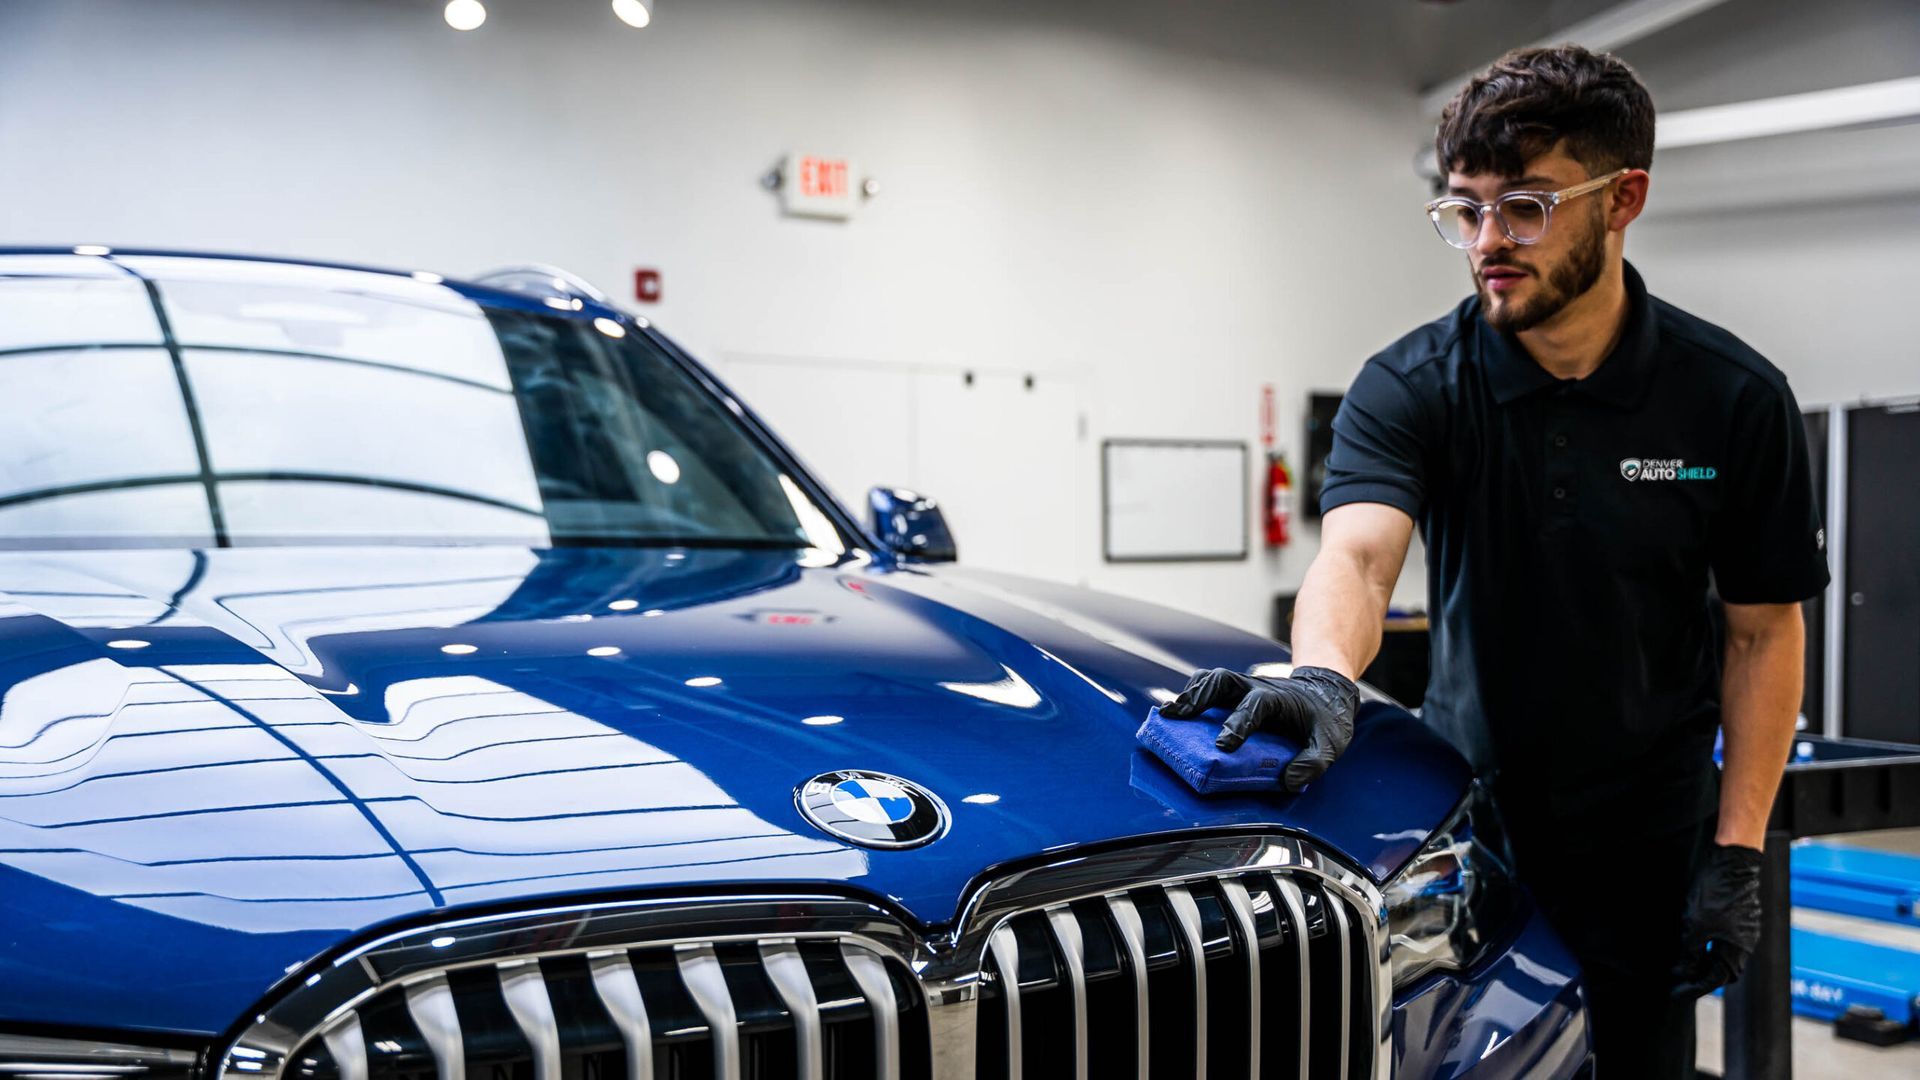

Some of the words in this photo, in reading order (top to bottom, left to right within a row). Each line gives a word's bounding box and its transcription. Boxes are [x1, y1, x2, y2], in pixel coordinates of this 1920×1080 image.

[800, 156, 848, 197] EXIT
[1642, 459, 1683, 469] DENVER
[1640, 468, 1676, 480] AUTO
[1677, 467, 1717, 480] SHIELD
